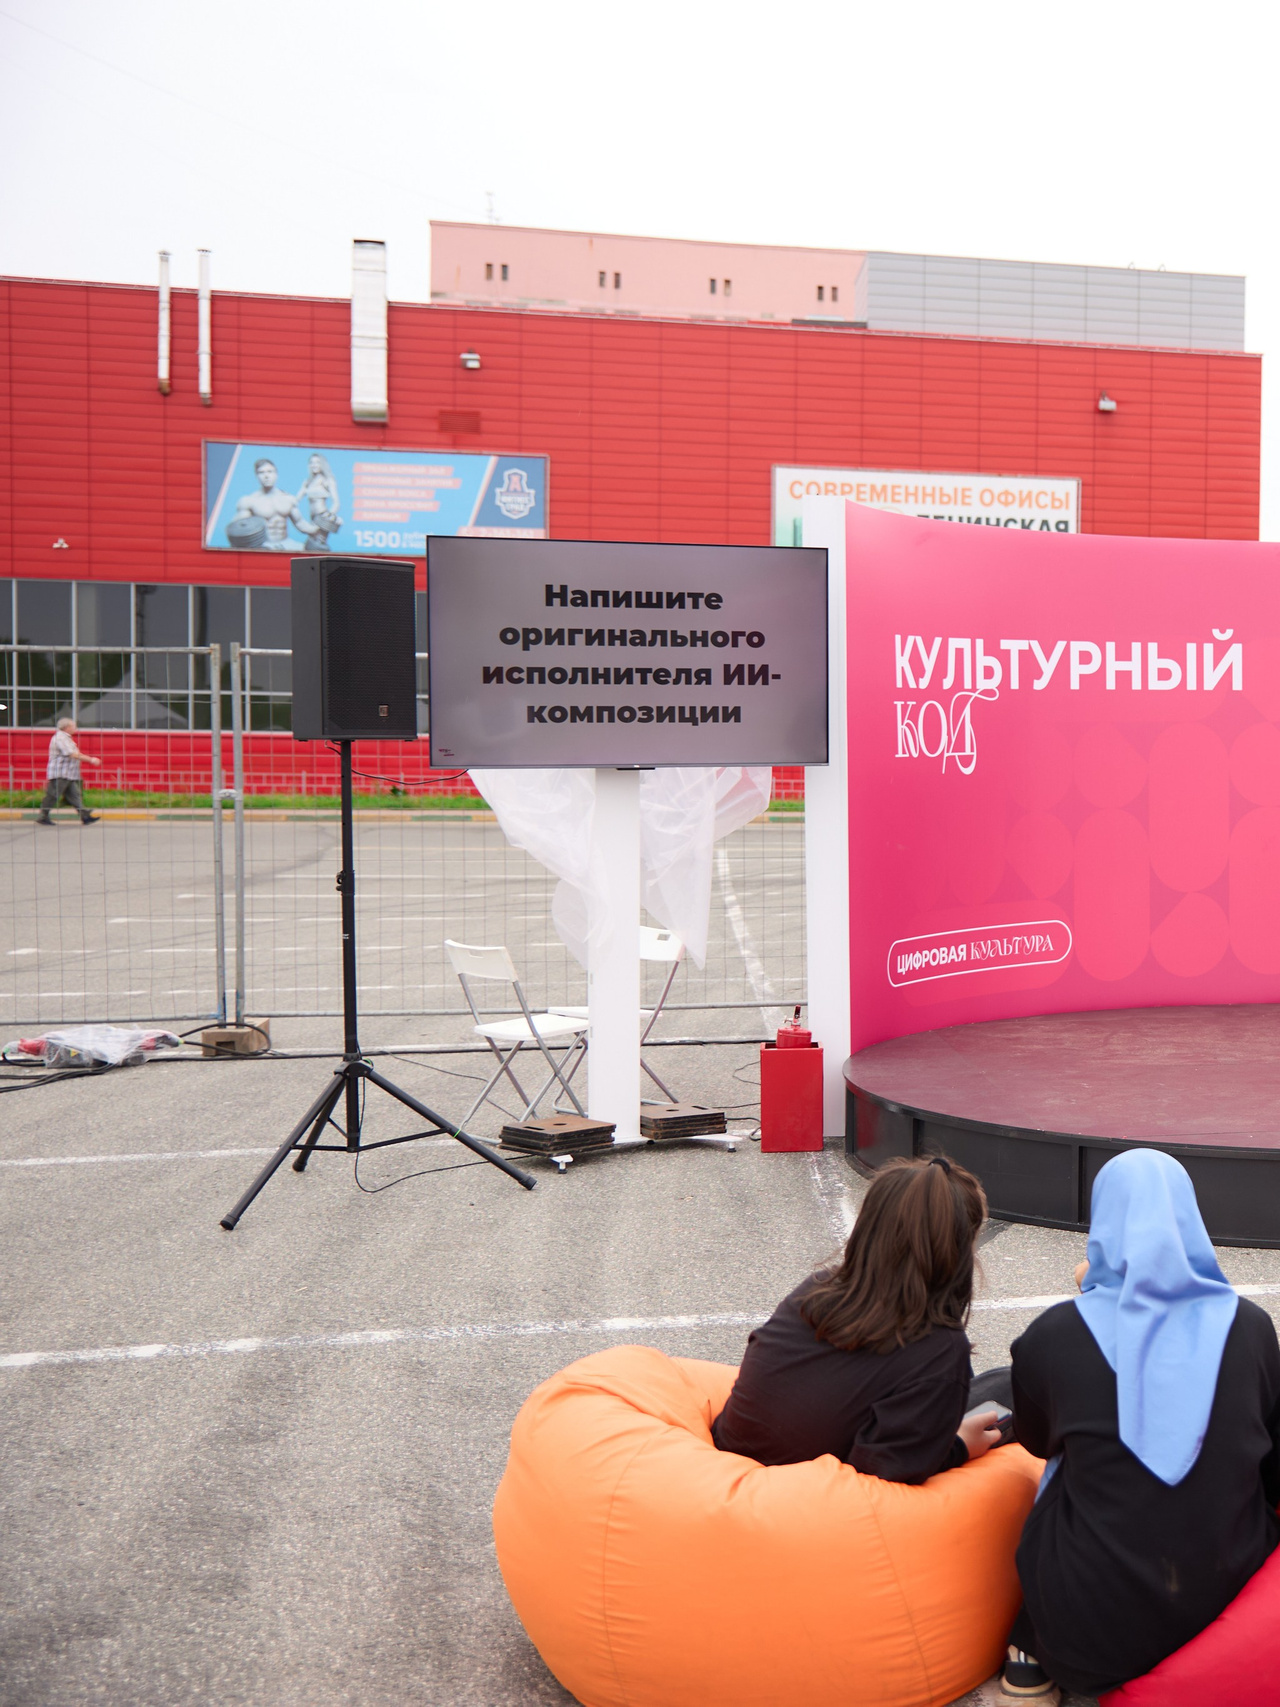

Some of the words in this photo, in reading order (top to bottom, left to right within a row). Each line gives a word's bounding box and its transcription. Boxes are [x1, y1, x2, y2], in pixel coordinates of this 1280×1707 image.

[789, 480, 972, 506] СОВРЕМЕННЫЕ
[979, 488, 1070, 510] ОФИСЫ
[354, 530, 401, 548] 1500
[545, 584, 723, 610] Напишите
[499, 625, 766, 651] оригинального
[894, 628, 1243, 690] КУЛЬТУРНЫЙ
[482, 665, 712, 686] исполнителя
[723, 663, 782, 686] ИИ-
[526, 704, 742, 726] композиции
[894, 687, 1000, 775] КОД
[897, 944, 967, 975] ЦИФРОВАЯ
[970, 933, 1054, 960] КУЛЬТУРА
